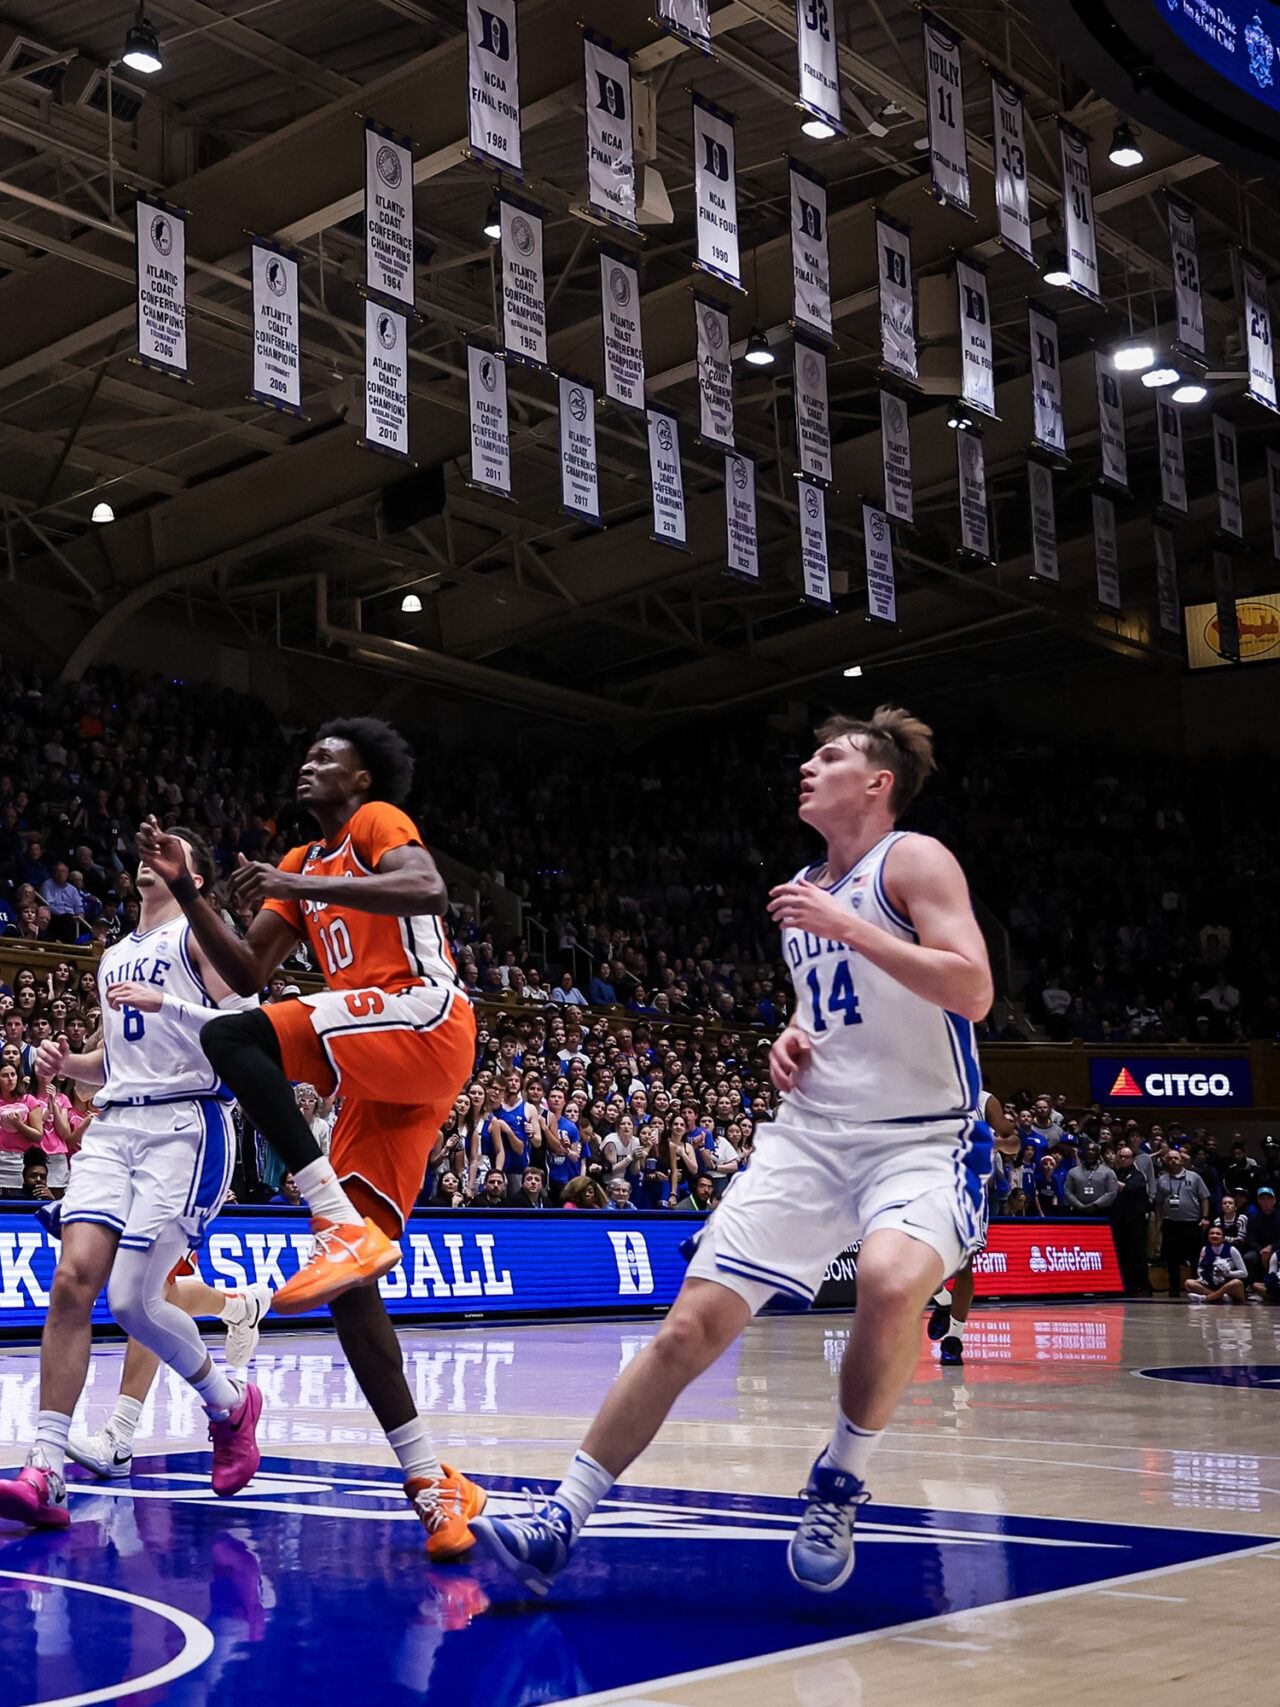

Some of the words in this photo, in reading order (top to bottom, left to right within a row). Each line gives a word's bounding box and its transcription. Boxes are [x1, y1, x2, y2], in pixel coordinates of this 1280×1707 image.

[484, 70, 507, 93] NCAA
[471, 87, 497, 111] FINAL
[937, 86, 956, 128] 11
[486, 131, 507, 151] 1988
[601, 131, 623, 151] NCAA
[1001, 136, 1024, 180] 33
[374, 194, 406, 218] ATLANTIC
[709, 191, 727, 211] NCAA
[1071, 185, 1089, 225] 31
[379, 211, 402, 230] COAST
[699, 206, 718, 227] FINAL
[369, 220, 412, 250] CONFERENCE
[371, 236, 411, 264] CHAMPIONS
[712, 245, 728, 263] 1990
[804, 251, 819, 268] NCAA
[146, 264, 178, 286] ATLANTIC
[382, 273, 401, 291] 1964
[509, 262, 538, 283] ATLANTIC
[795, 266, 814, 284] FINAL
[1176, 252, 1198, 293] 22
[151, 280, 174, 298] COAST
[515, 277, 534, 295] COAST
[141, 289, 186, 317] CONFERENCE
[505, 287, 544, 312] CONFERENCE
[143, 305, 184, 330] CHAMPIONS
[261, 305, 293, 325] ATLANTIC
[507, 302, 544, 326] CHAMPIONS
[610, 312, 636, 332] ATLANTIC
[267, 319, 288, 336] COAST
[614, 327, 631, 343] COAST
[1251, 307, 1269, 345] 23
[154, 340, 173, 358] 2006
[255, 330, 297, 356] CONFERENCE
[520, 335, 537, 351] 1965
[606, 336, 642, 361] CONFERENCE
[971, 335, 986, 350] NCAA
[257, 344, 297, 368] CHAMPIONS
[608, 350, 642, 373] CHAMPIONS
[372, 357, 401, 377] ATLANTIC
[270, 377, 287, 394] 2009
[378, 371, 397, 388] COAST
[367, 380, 406, 405] CONFERENCE
[616, 383, 632, 399] 1966
[368, 395, 405, 418] CHAMPIONS
[476, 400, 502, 418] ATLANTIC
[481, 414, 498, 429] COAST
[379, 426, 397, 442] 2010
[472, 423, 509, 445] CONFERENCE
[568, 430, 592, 447] ATLANTIC
[475, 436, 509, 457] CHAMPIONS
[572, 443, 587, 458] COAST
[485, 467, 501, 481] 2011
[565, 464, 596, 484] CHAMPIONS
[574, 494, 588, 507] 2017
[319, 918, 354, 976] 10
[105, 957, 172, 987] DUKE
[806, 960, 863, 1032] 14
[122, 1003, 145, 1042] 8
[1145, 1073, 1231, 1097] CITGO
